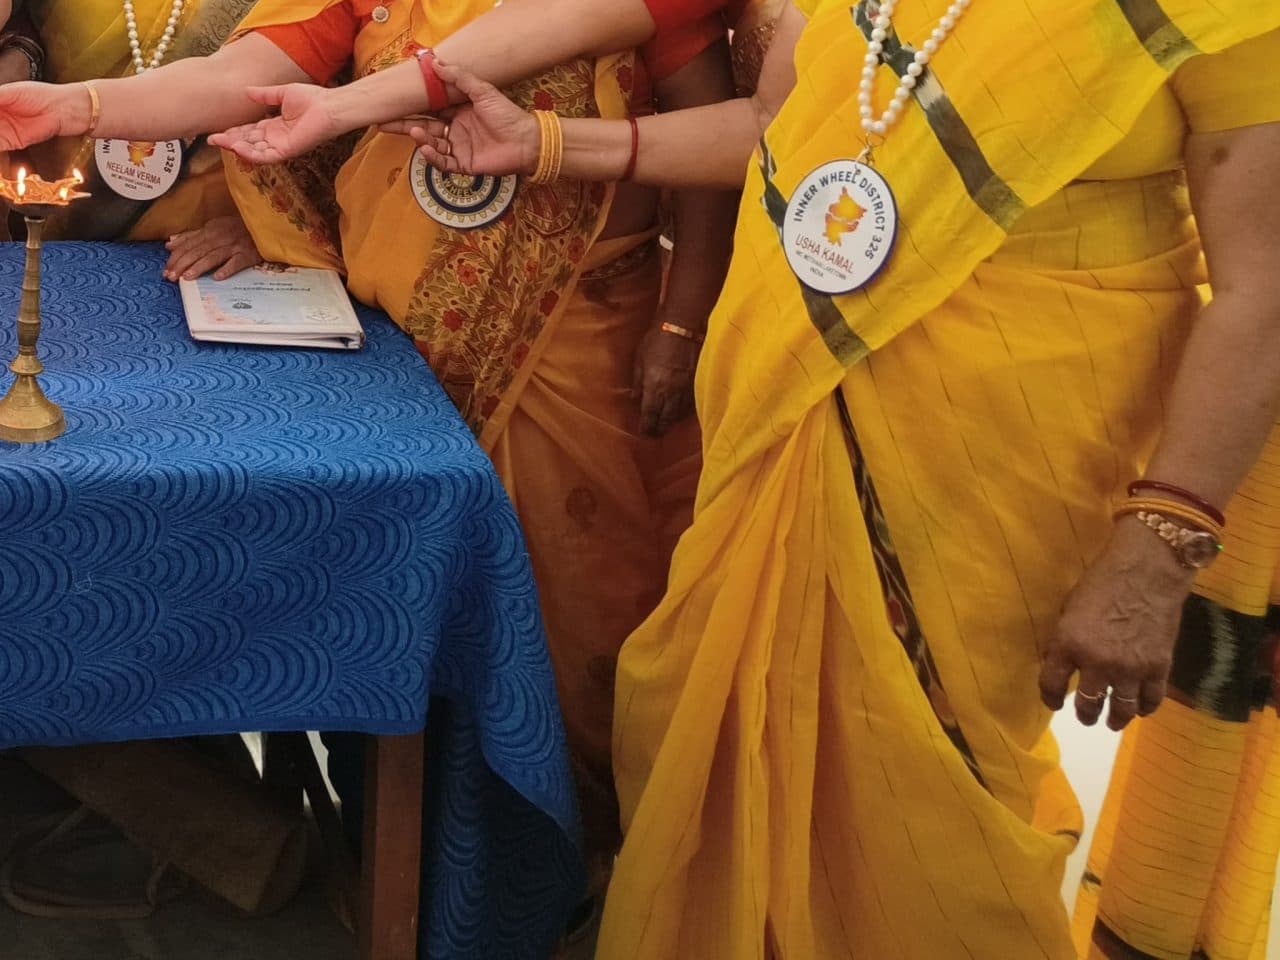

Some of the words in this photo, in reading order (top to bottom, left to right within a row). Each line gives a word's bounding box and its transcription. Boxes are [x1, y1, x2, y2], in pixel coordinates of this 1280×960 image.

[106, 160, 136, 177] NEELAM
[137, 170, 161, 186] VERMA
[163, 155, 175, 174] 325
[818, 170, 857, 189] WHEEL
[793, 183, 819, 222] INNER
[859, 177, 886, 232] DISTRICT
[795, 233, 821, 256] USHA
[821, 247, 855, 275] KAMAL
[864, 234, 883, 260] 325
